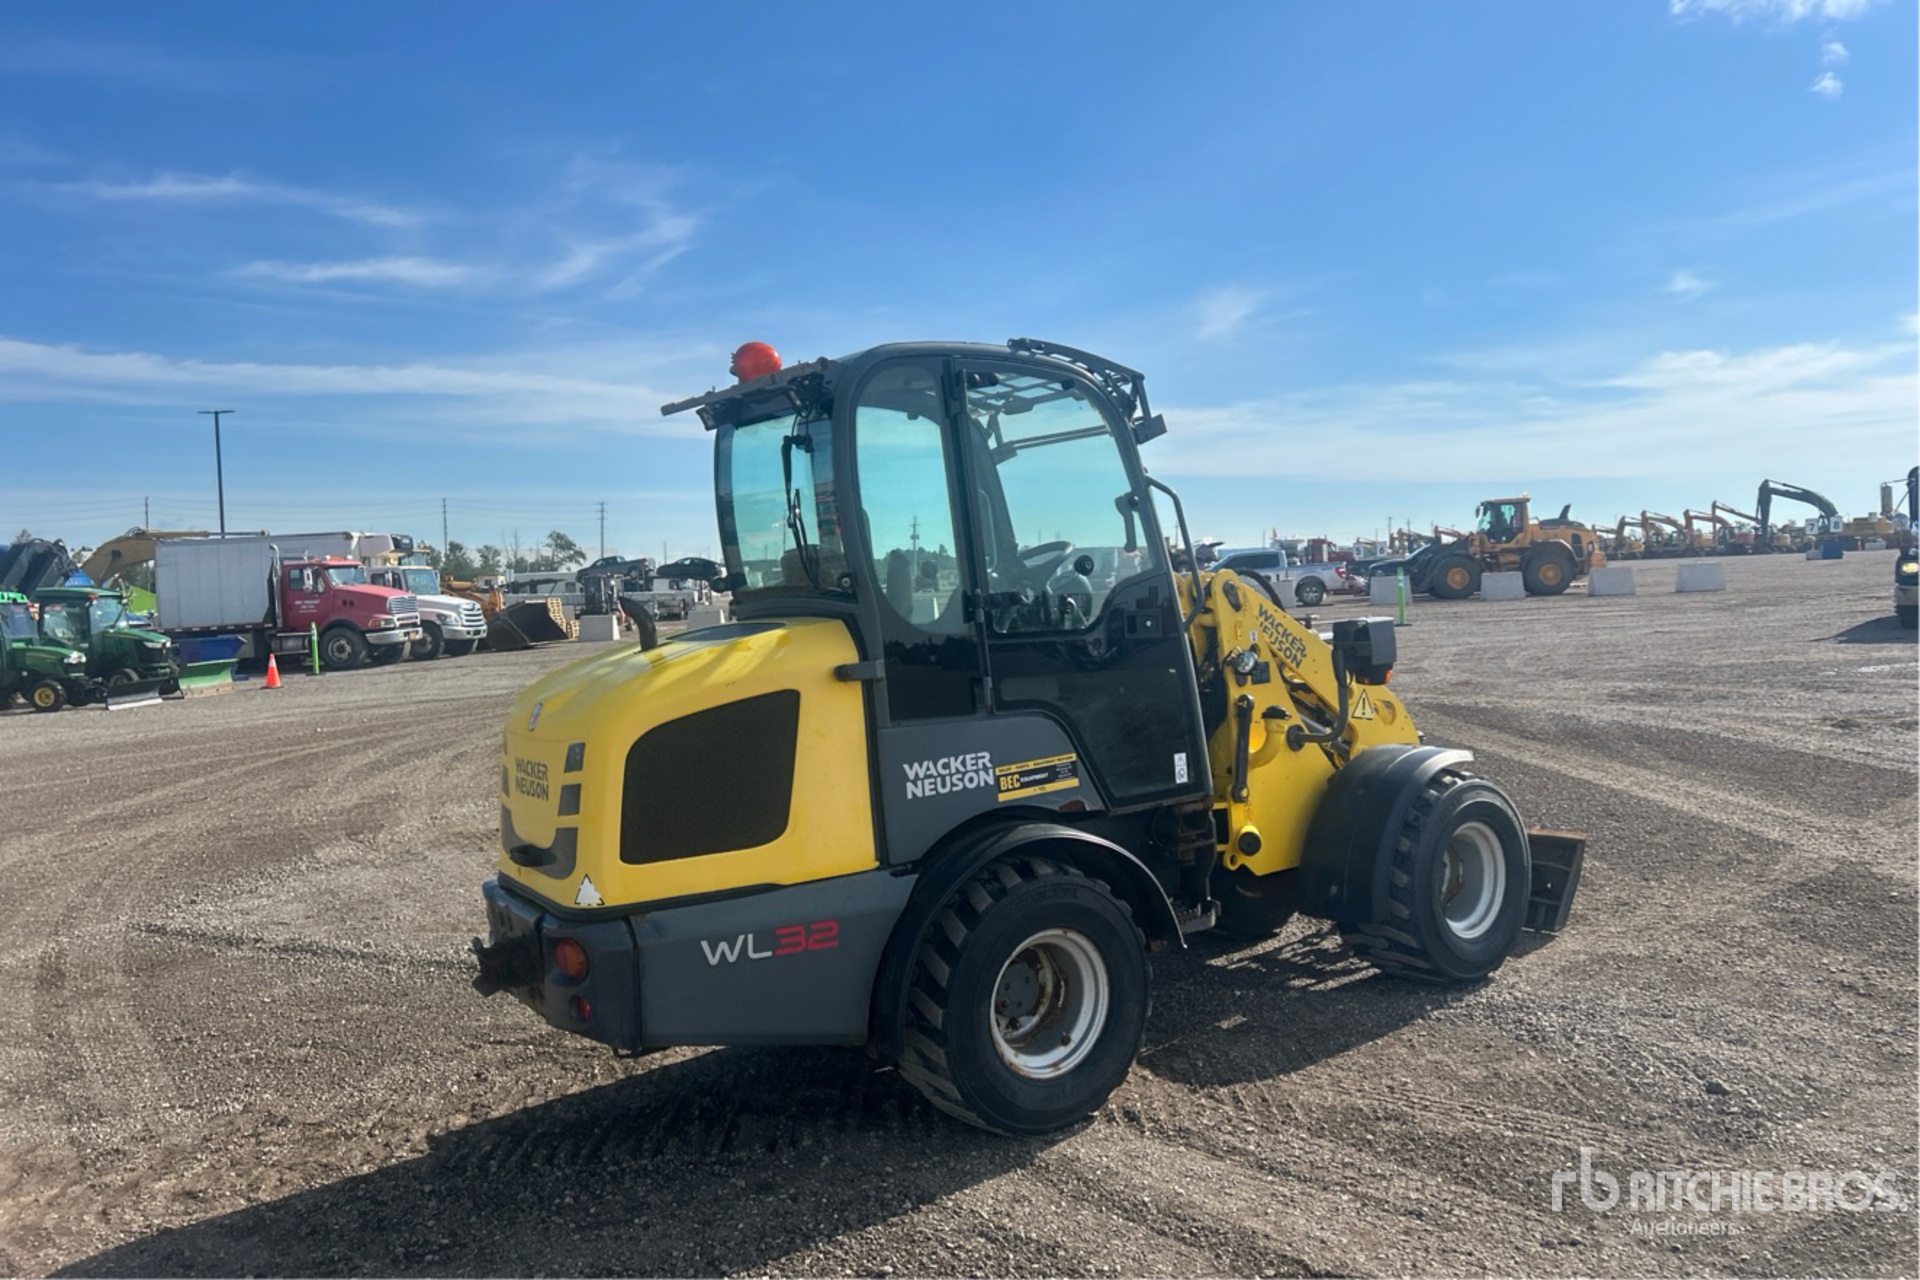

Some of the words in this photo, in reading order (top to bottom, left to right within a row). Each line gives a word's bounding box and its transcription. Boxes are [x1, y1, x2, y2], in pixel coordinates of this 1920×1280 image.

[1833, 520, 1841, 530] 8
[1258, 603, 1307, 658] WACKER
[514, 757, 548, 782] WACKER
[903, 751, 993, 780] WACKER
[514, 775, 549, 802] NEUSON
[905, 768, 995, 799] NEUSON
[999, 773, 1021, 791] BEC
[700, 920, 838, 966] WL32
